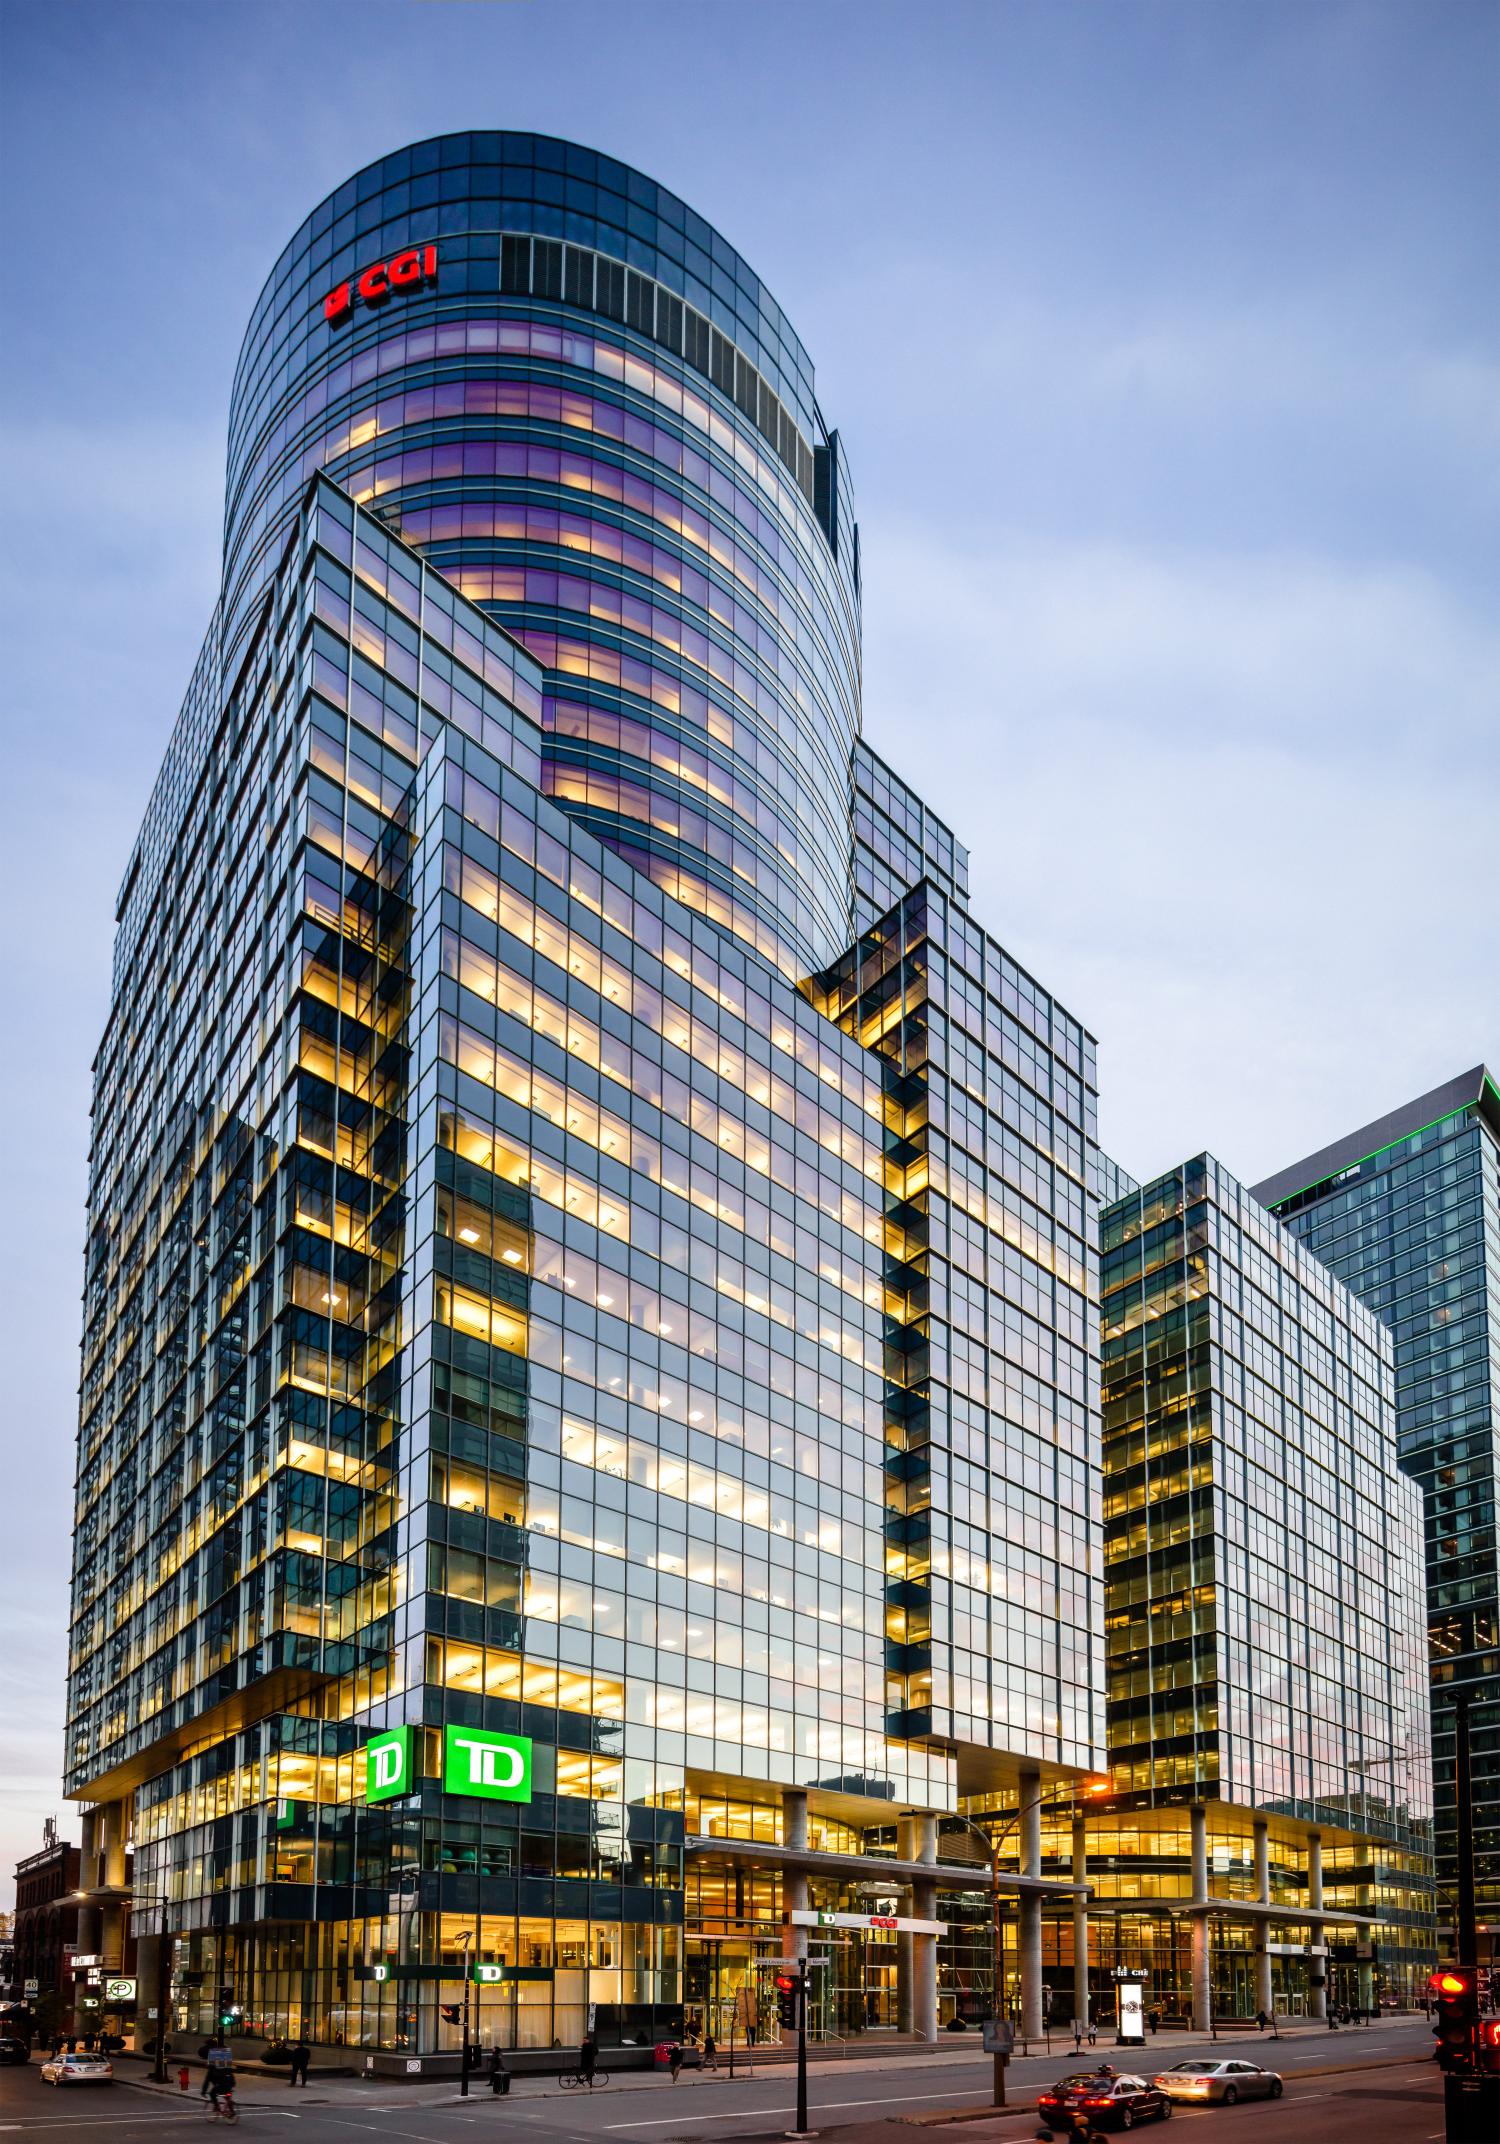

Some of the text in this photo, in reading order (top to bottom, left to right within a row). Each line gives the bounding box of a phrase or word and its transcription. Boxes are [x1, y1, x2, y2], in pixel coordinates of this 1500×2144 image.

[358, 245, 437, 300] CGI
[370, 1741, 403, 1789] TD
[455, 1738, 524, 1788] TD
[822, 1913, 835, 1924] TD
[879, 1917, 898, 1929] CGI
[374, 1966, 386, 1980] TD
[478, 1966, 501, 1981] TD
